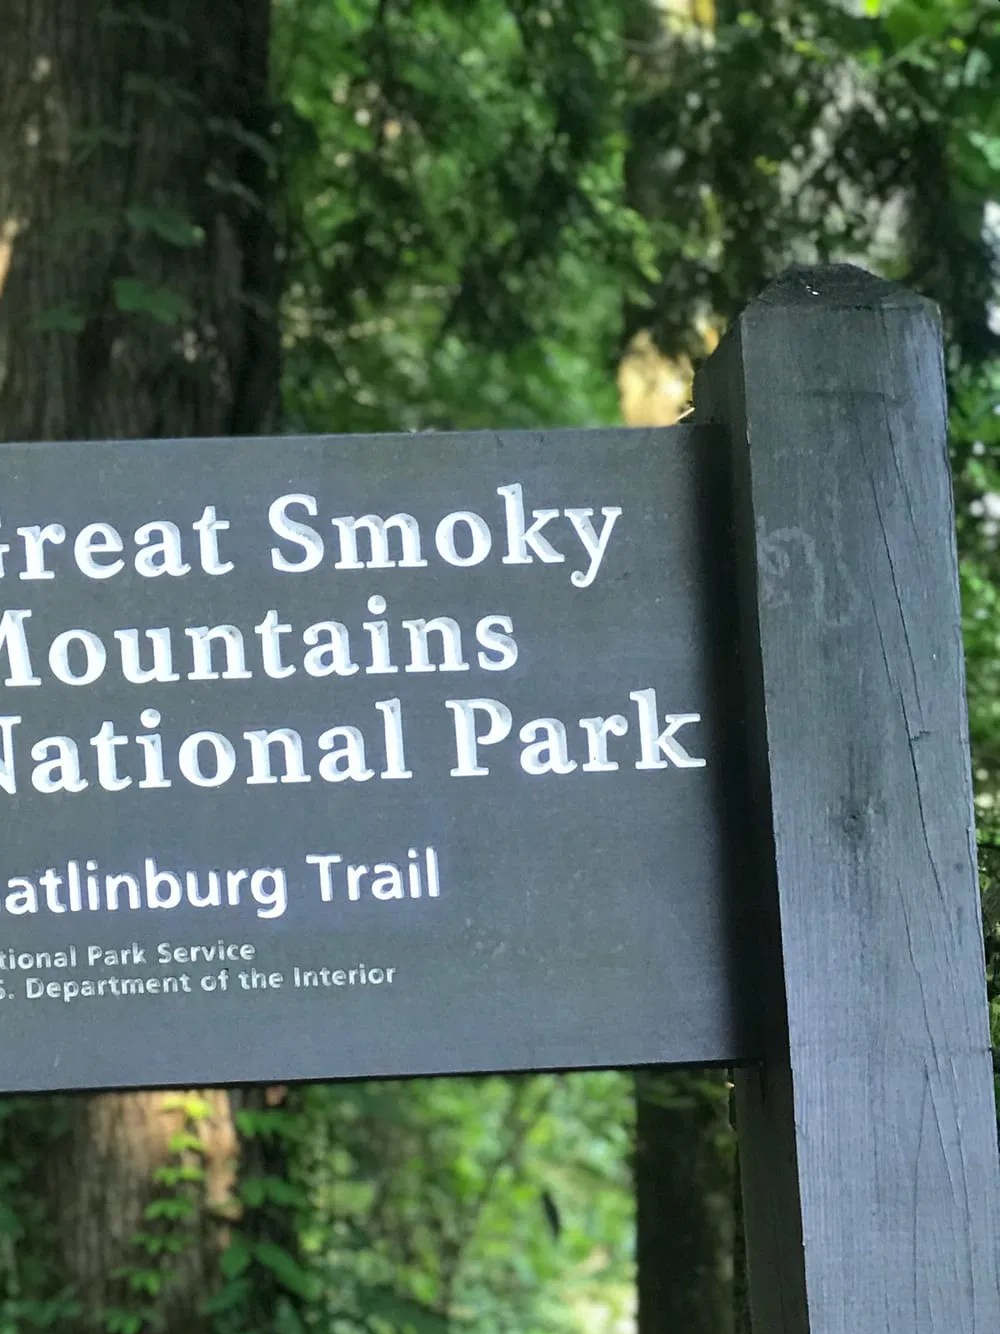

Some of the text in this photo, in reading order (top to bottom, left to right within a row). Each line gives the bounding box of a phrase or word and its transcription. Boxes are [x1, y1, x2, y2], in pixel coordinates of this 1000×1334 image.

[268, 482, 623, 588] Smoky
[446, 688, 707, 777] Park
[305, 846, 441, 902] Trail
[88, 942, 147, 967] Park
[157, 939, 256, 964] Service
[26, 971, 192, 1002] Department
[200, 968, 229, 991] of
[238, 968, 284, 989] the
[293, 963, 397, 988] Interior
